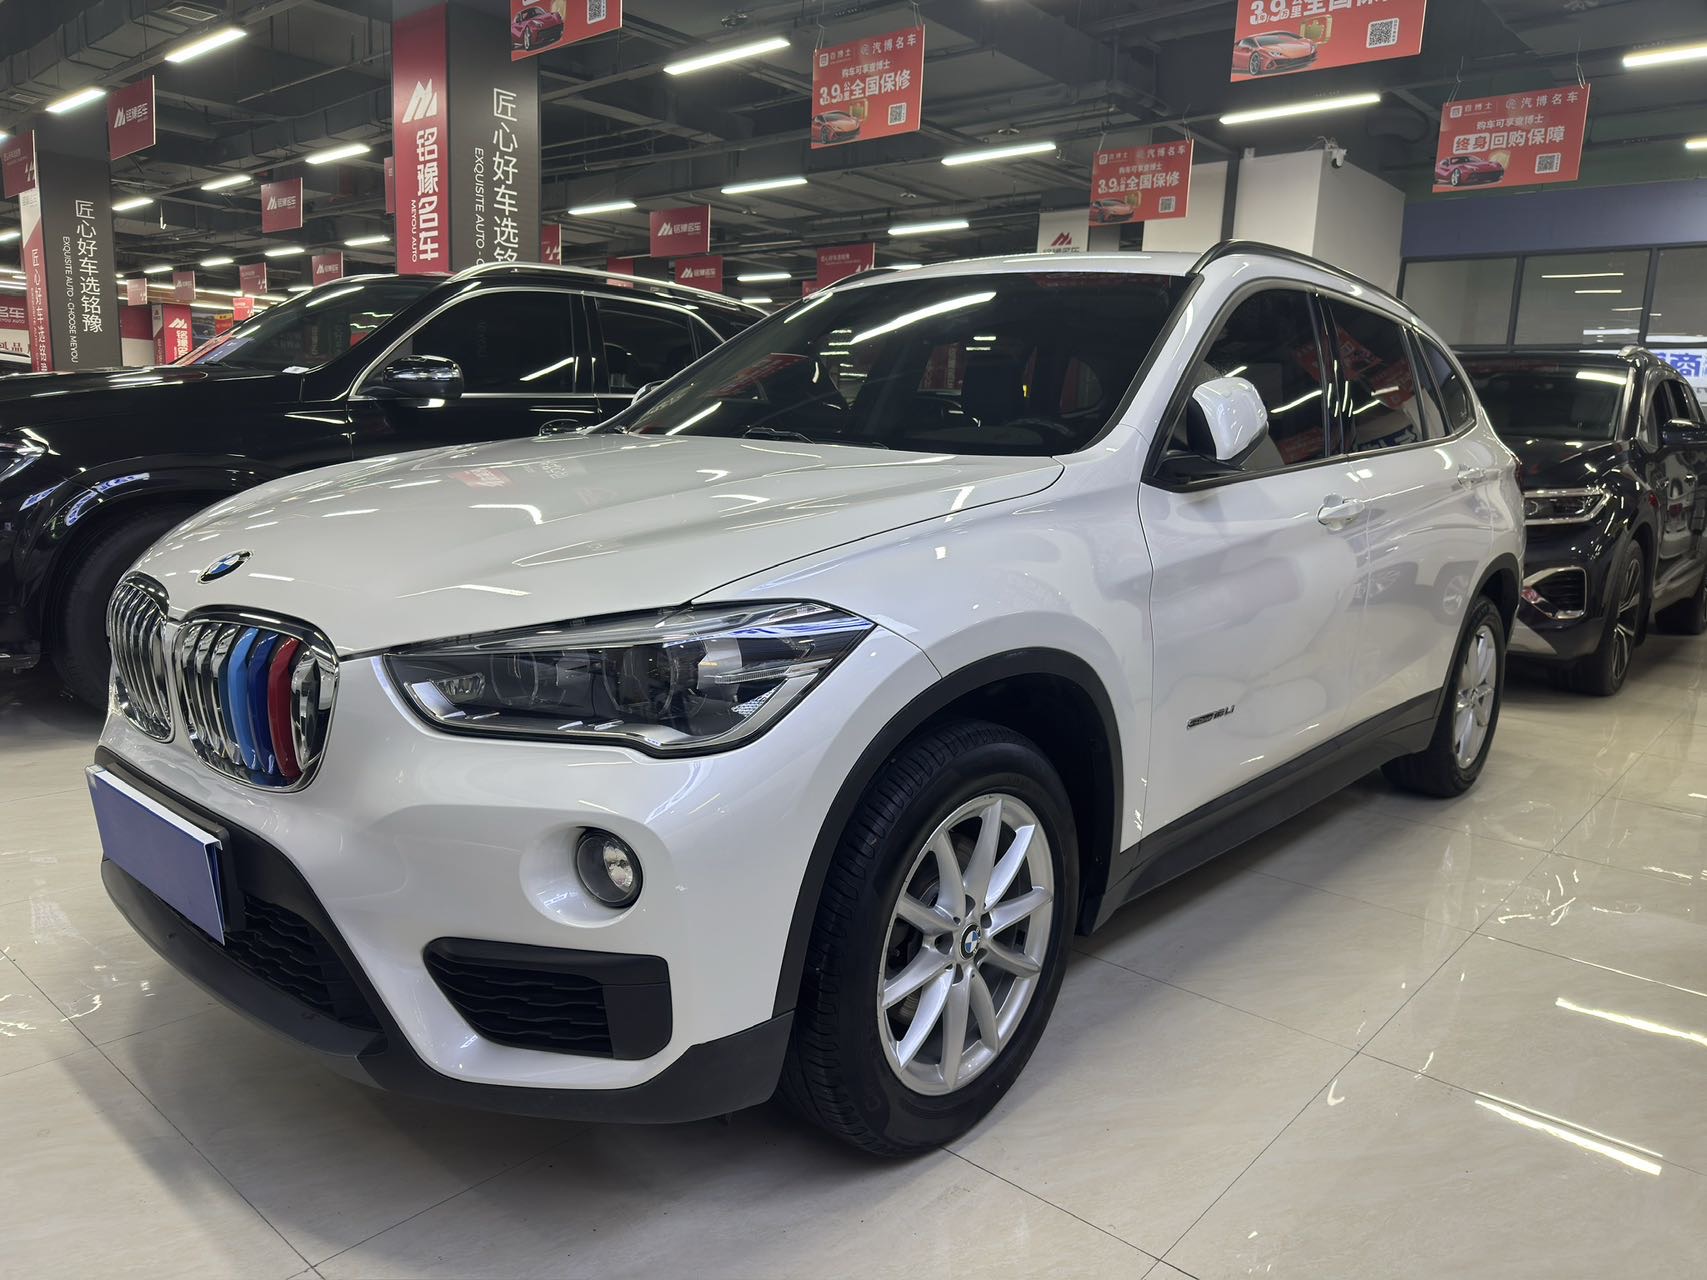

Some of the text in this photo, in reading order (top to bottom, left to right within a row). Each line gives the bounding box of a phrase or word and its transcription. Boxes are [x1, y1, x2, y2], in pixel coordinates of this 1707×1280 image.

[872, 33, 917, 55] 汽博名车
[1521, 91, 1579, 109] 汽博名车
[1454, 125, 1566, 152] 终身回购保障
[416, 127, 439, 261] 铭豫名车
[474, 147, 485, 213] EXQUISITE
[475, 214, 485, 249] AUTO
[63, 236, 73, 275] EXQUISITE
[75, 199, 103, 333] 匠心好车选铭豫
[66, 276, 74, 297] AUTO
[67, 302, 76, 334] CHOOSE
[70, 335, 79, 363] MEYOU
